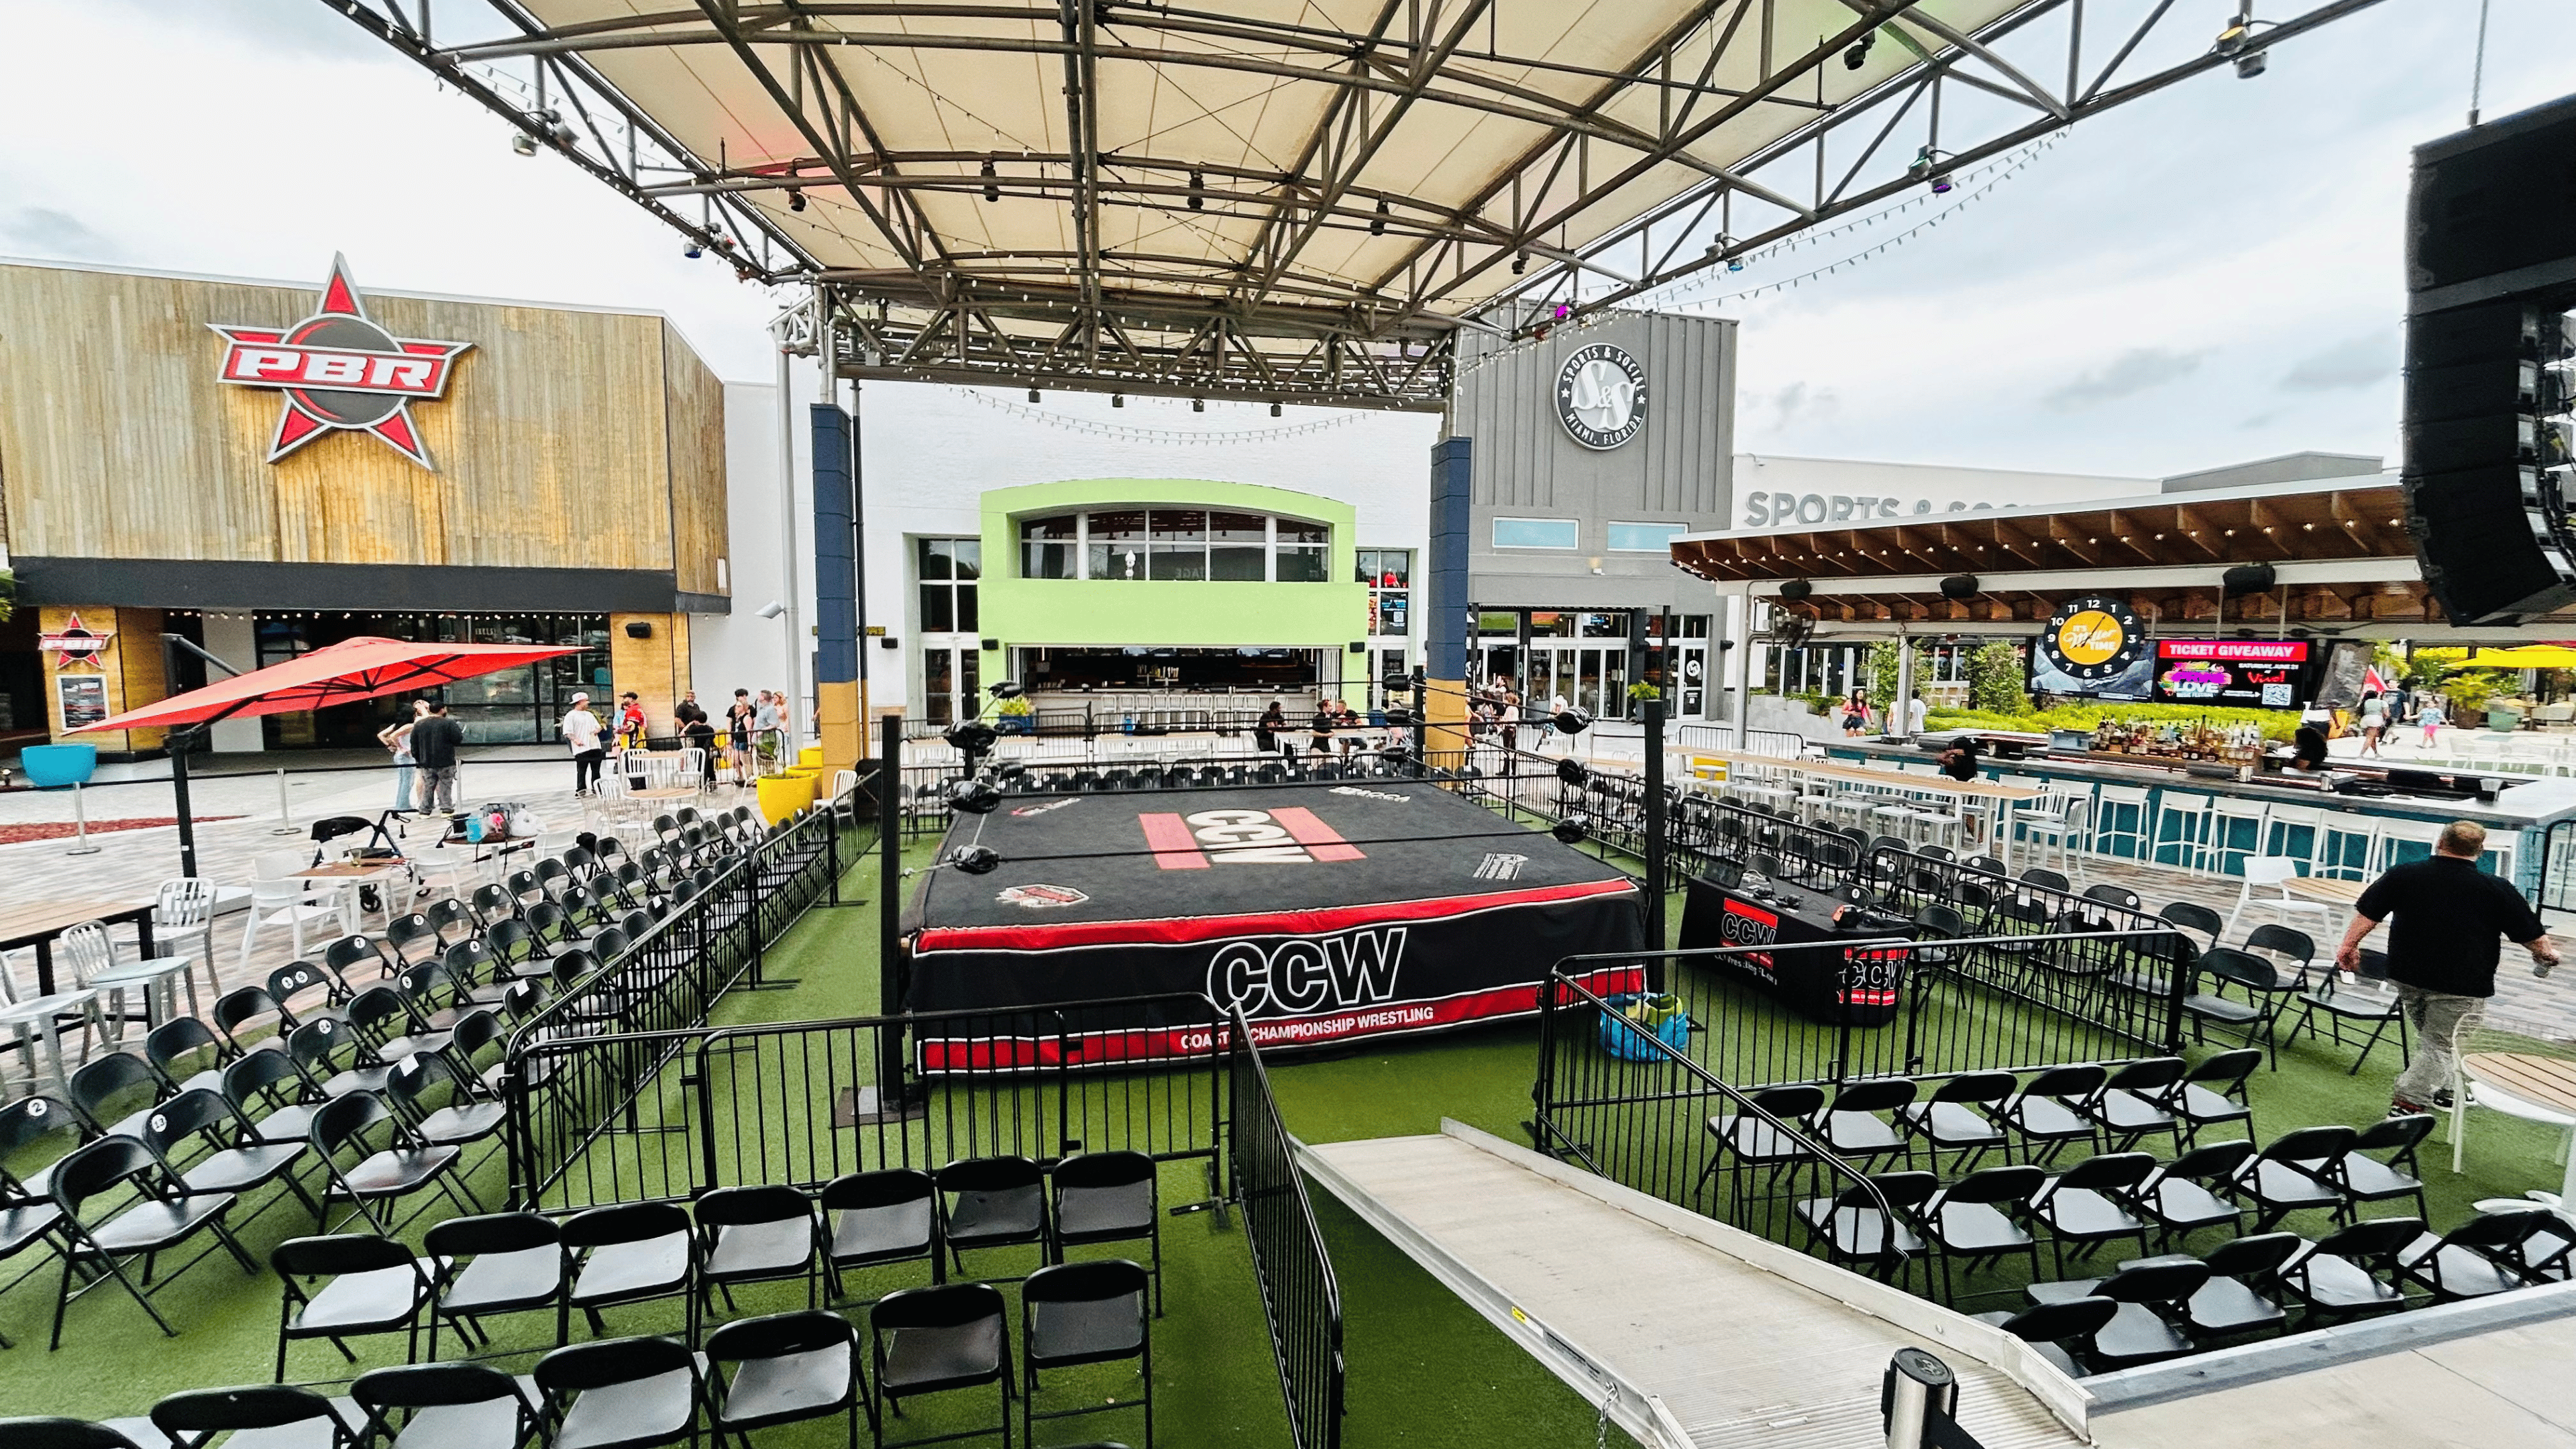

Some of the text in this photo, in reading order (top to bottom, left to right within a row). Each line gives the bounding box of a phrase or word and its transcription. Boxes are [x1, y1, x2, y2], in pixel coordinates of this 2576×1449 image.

[235, 348, 433, 388] PBR
[1562, 346, 1646, 392] SPORTS & SOCIAL
[1566, 413, 1642, 445] MIAMI, FLORIDA
[1744, 491, 1900, 527] SPORTS
[2068, 604, 2078, 613] 11
[2087, 600, 2100, 608] 12
[2110, 604, 2116, 613] 1
[2051, 617, 2064, 626] 10
[2123, 616, 2133, 625] 2
[2047, 633, 2056, 643] 9
[2127, 635, 2137, 643] 3
[42, 639, 104, 649] PBR
[2090, 641, 2116, 651] TIME
[2051, 650, 2059, 659] 8
[2120, 651, 2130, 660] 4
[2169, 645, 2294, 657] TICKET GIVEAWAY
[2065, 663, 2073, 672] 7
[2083, 668, 2092, 677] 6
[2104, 664, 2112, 674] 5
[2174, 682, 2219, 693] LOVE
[1187, 809, 1313, 863] CCW
[1721, 913, 1776, 946] CCW
[1208, 927, 1407, 1016] CCW
[1250, 1017, 1355, 1041] CHAMPIONSHIP
[1357, 1006, 1434, 1031] WRESTLING
[155, 1118, 165, 1128] 13
